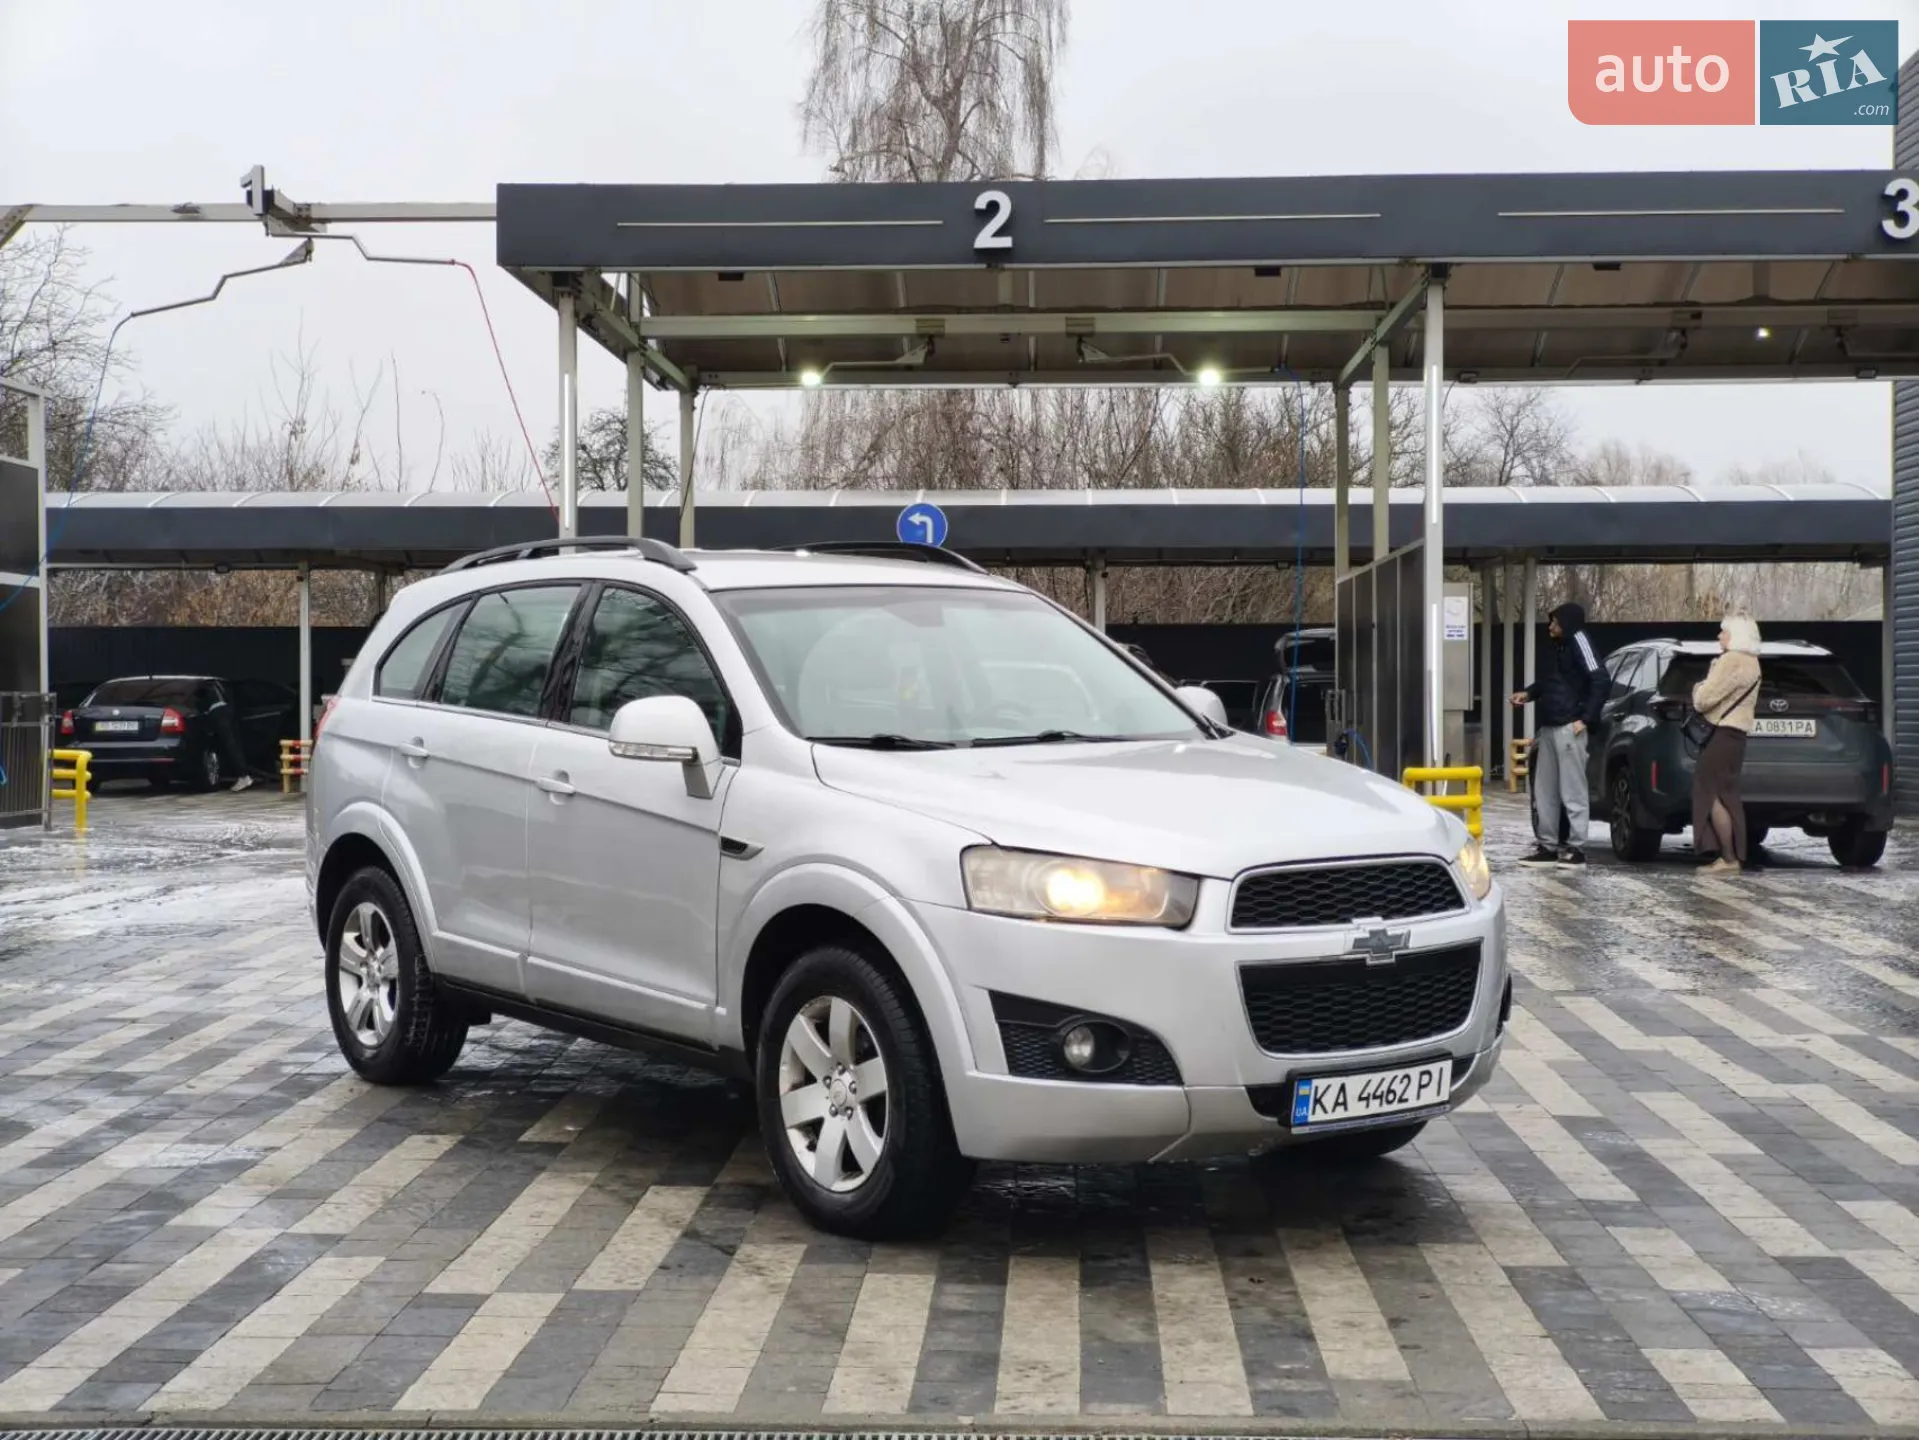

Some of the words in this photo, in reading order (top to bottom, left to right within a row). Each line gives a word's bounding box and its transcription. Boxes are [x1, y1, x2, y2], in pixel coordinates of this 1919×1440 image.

[240, 165, 264, 216] 1
[1881, 178, 1919, 239] 3
[974, 190, 1013, 249] 2
[1311, 1082, 1349, 1116] KA
[1357, 1073, 1412, 1110] 4462
[1416, 1066, 1444, 1100] PI
